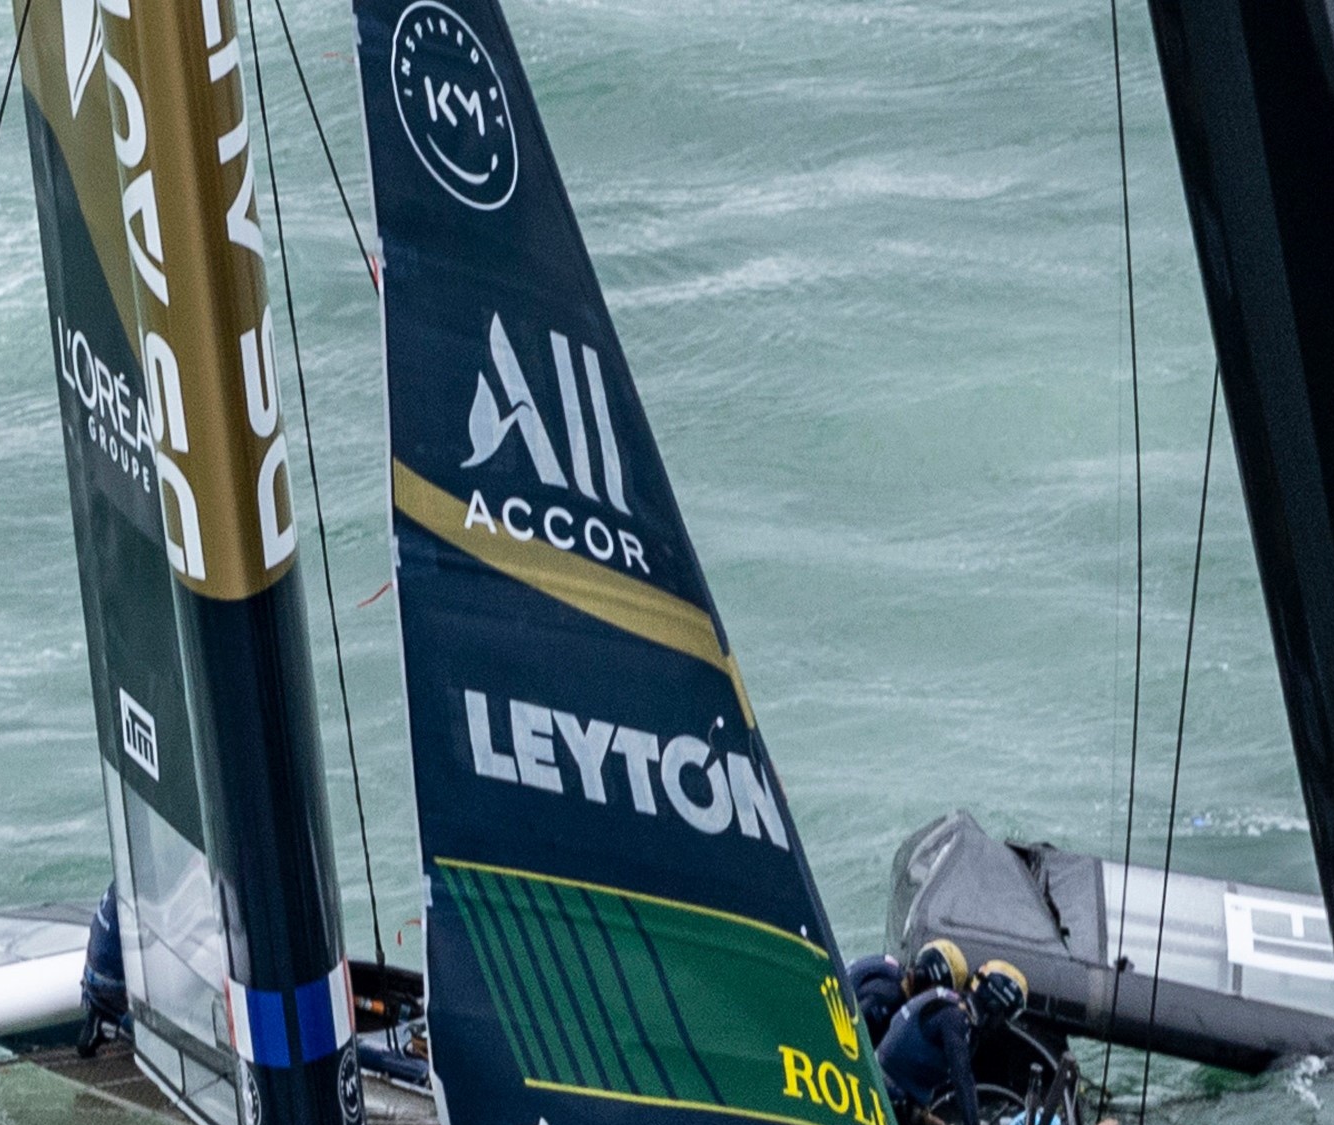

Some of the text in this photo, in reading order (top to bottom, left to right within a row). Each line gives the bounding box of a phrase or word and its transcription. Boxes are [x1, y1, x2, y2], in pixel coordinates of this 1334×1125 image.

[424, 76, 486, 136] KM
[57, 316, 157, 467] L'ORÉA
[88, 415, 151, 494] GROUPE
[464, 489, 651, 575] ACCOR
[465, 689, 790, 851] LEYTON
